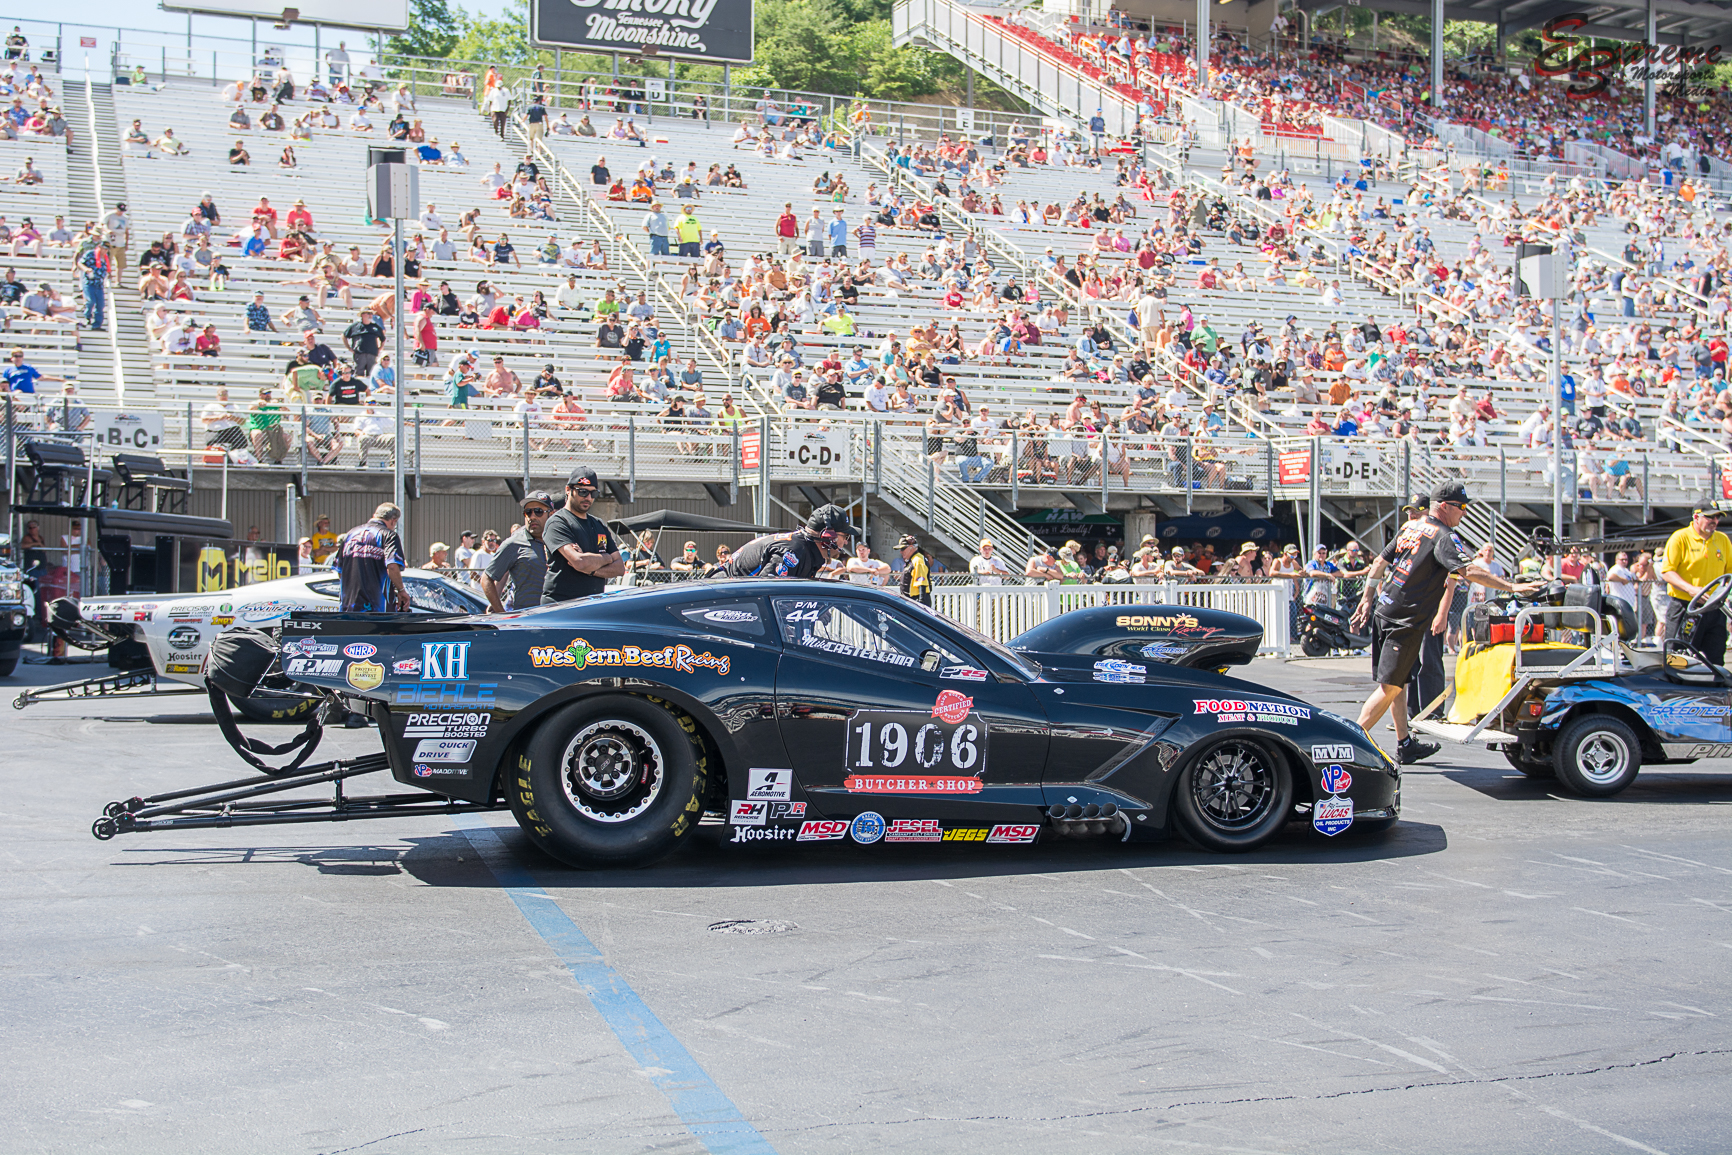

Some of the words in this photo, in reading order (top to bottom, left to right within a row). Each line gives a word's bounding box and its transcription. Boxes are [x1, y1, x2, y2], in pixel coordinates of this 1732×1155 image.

[617, 12, 664, 27] Tennessee
[586, 13, 707, 52] Moonshine
[798, 445, 832, 465] C-D
[1343, 462, 1370, 479] D-E
[1060, 524, 1094, 537] Loudly!
[786, 610, 819, 622] 44
[1116, 613, 1199, 628] SONNY'S
[284, 620, 322, 630] FLEX
[1167, 621, 1225, 639] Racing
[347, 644, 374, 656] NHRA
[802, 633, 829, 650] Mike
[824, 641, 915, 668] CASTELLANA
[1140, 645, 1187, 654] SPEEDTECH
[167, 652, 202, 662] Hoosier
[420, 641, 472, 681] KH
[529, 638, 621, 671] Western
[623, 647, 675, 668] Beef
[675, 645, 730, 675] Racing
[287, 659, 341, 672] RPM
[396, 683, 498, 703] BIEHLE
[934, 700, 971, 715] CERTIFIED
[407, 712, 491, 725] PRECISION
[1247, 714, 1256, 722] &
[1257, 713, 1298, 725] PRODUCE
[855, 722, 978, 769] 1906
[1314, 745, 1352, 759] MVM
[419, 751, 450, 759] DRIVE
[855, 778, 928, 790] BUTCHER
[936, 780, 976, 791] SHOP
[1322, 765, 1343, 793] VP
[750, 790, 787, 798] AEROMOTIVE
[736, 803, 766, 815] RH
[1319, 807, 1351, 818] LUCAS
[801, 821, 847, 834] MSD
[887, 820, 942, 833] JESEL
[991, 826, 1037, 838] MSD
[730, 825, 795, 843] Hoosier
[949, 828, 989, 842] JEGS
